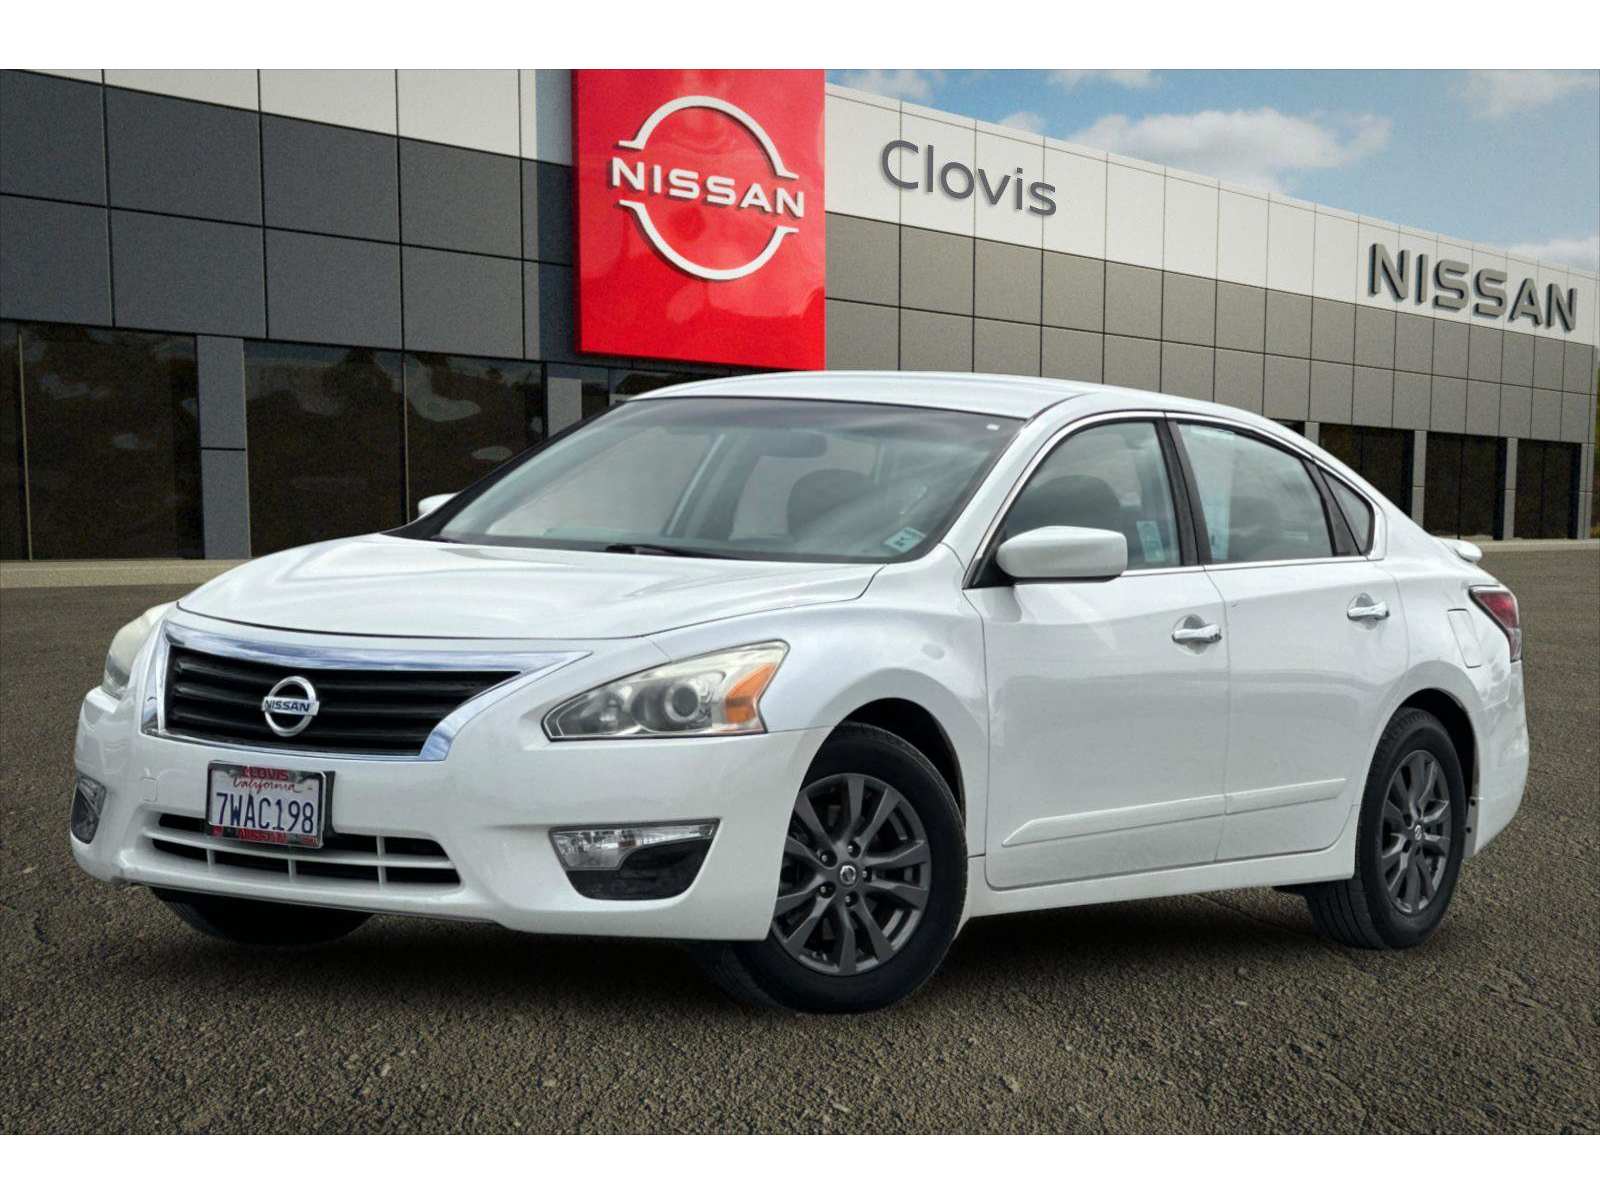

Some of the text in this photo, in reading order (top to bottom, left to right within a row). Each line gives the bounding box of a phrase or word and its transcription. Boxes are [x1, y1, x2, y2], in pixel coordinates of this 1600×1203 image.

[611, 156, 805, 218] NISSAN
[881, 139, 1057, 216] Clovis
[1368, 242, 1578, 332] NISSAN
[265, 699, 310, 712] NISSAN
[232, 776, 301, 794] California
[216, 792, 315, 834] 7WAC198
